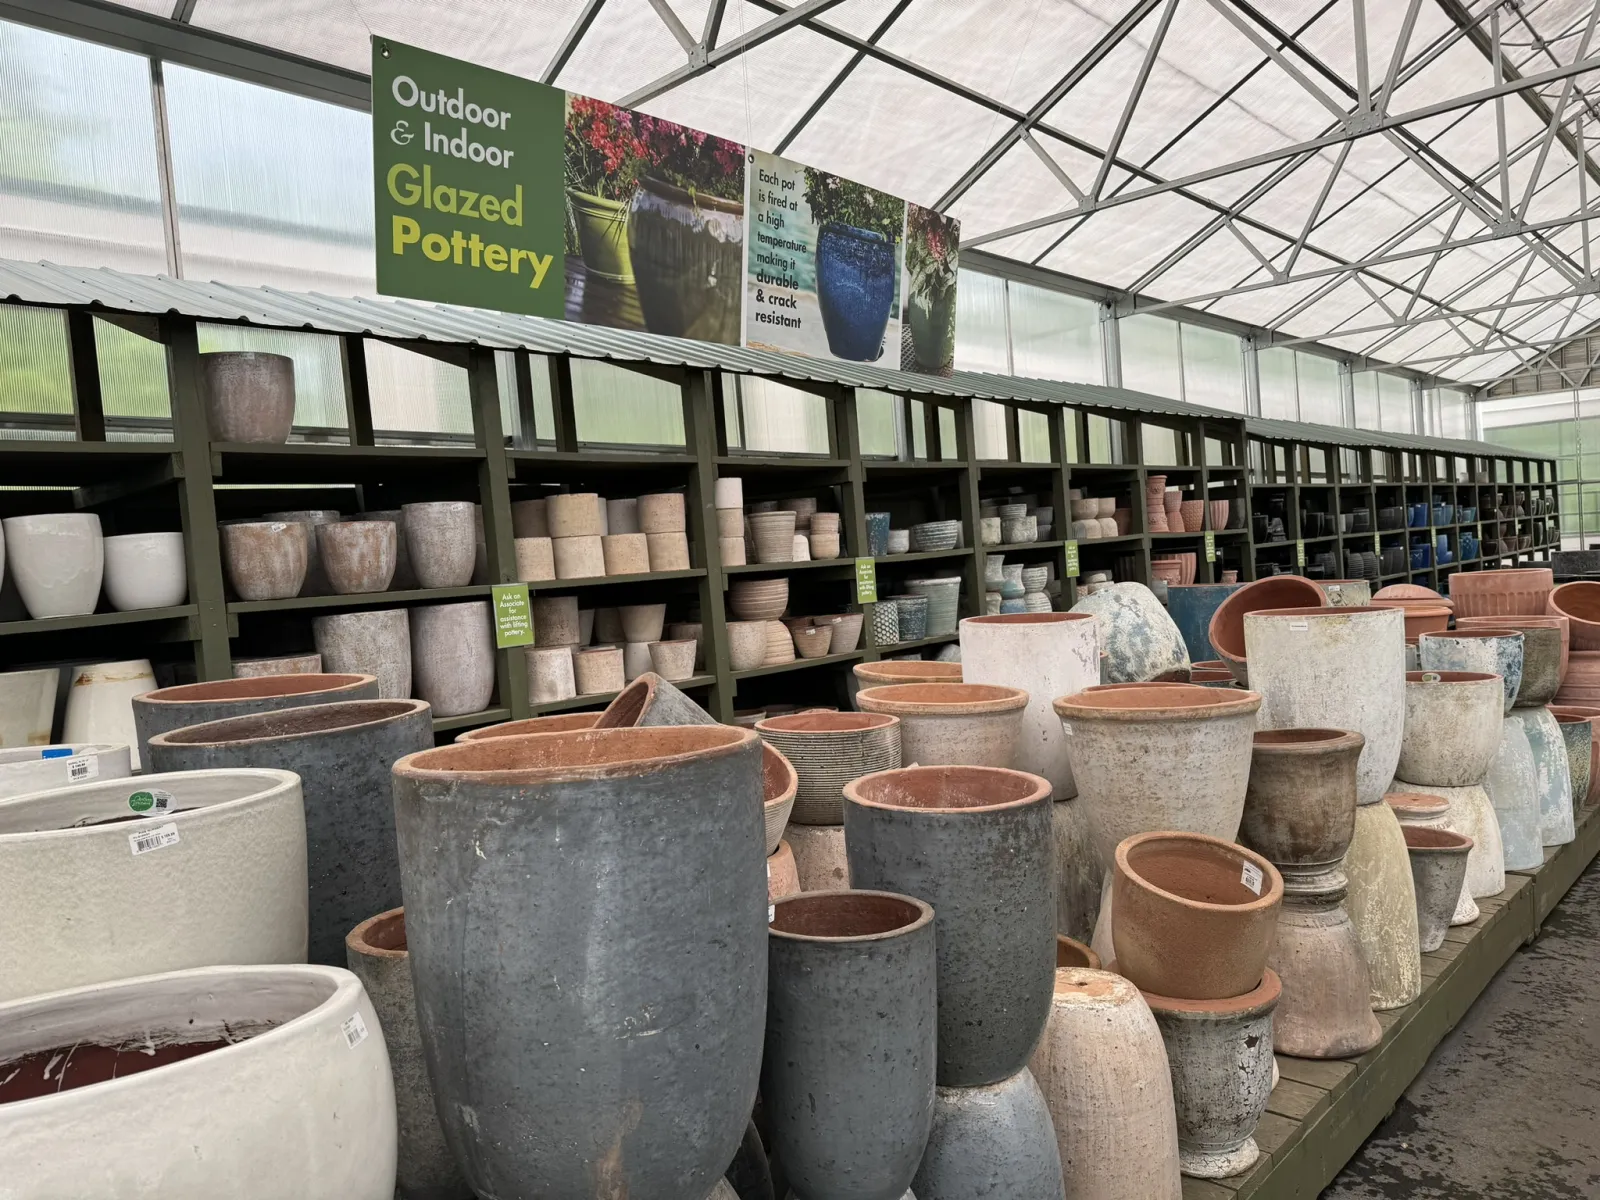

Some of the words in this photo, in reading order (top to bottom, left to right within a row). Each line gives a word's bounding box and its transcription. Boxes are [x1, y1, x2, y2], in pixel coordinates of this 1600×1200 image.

[392, 75, 511, 130] Outdoor
[390, 120, 414, 145] &
[424, 121, 514, 169] Indoor
[759, 169, 779, 187] Each
[781, 178, 795, 191] pot
[387, 163, 522, 227] Glazed
[758, 189, 765, 203] is
[768, 191, 787, 209] fired
[789, 200, 798, 212] at
[758, 213, 764, 222] a
[766, 211, 785, 229] high
[392, 215, 554, 289] Pottery
[757, 231, 807, 253] temperature
[757, 252, 788, 271] making
[790, 257, 796, 270] it
[756, 269, 799, 290] durable
[756, 289, 765, 303] &
[768, 294, 797, 309] crack
[755, 311, 801, 329] resistant
